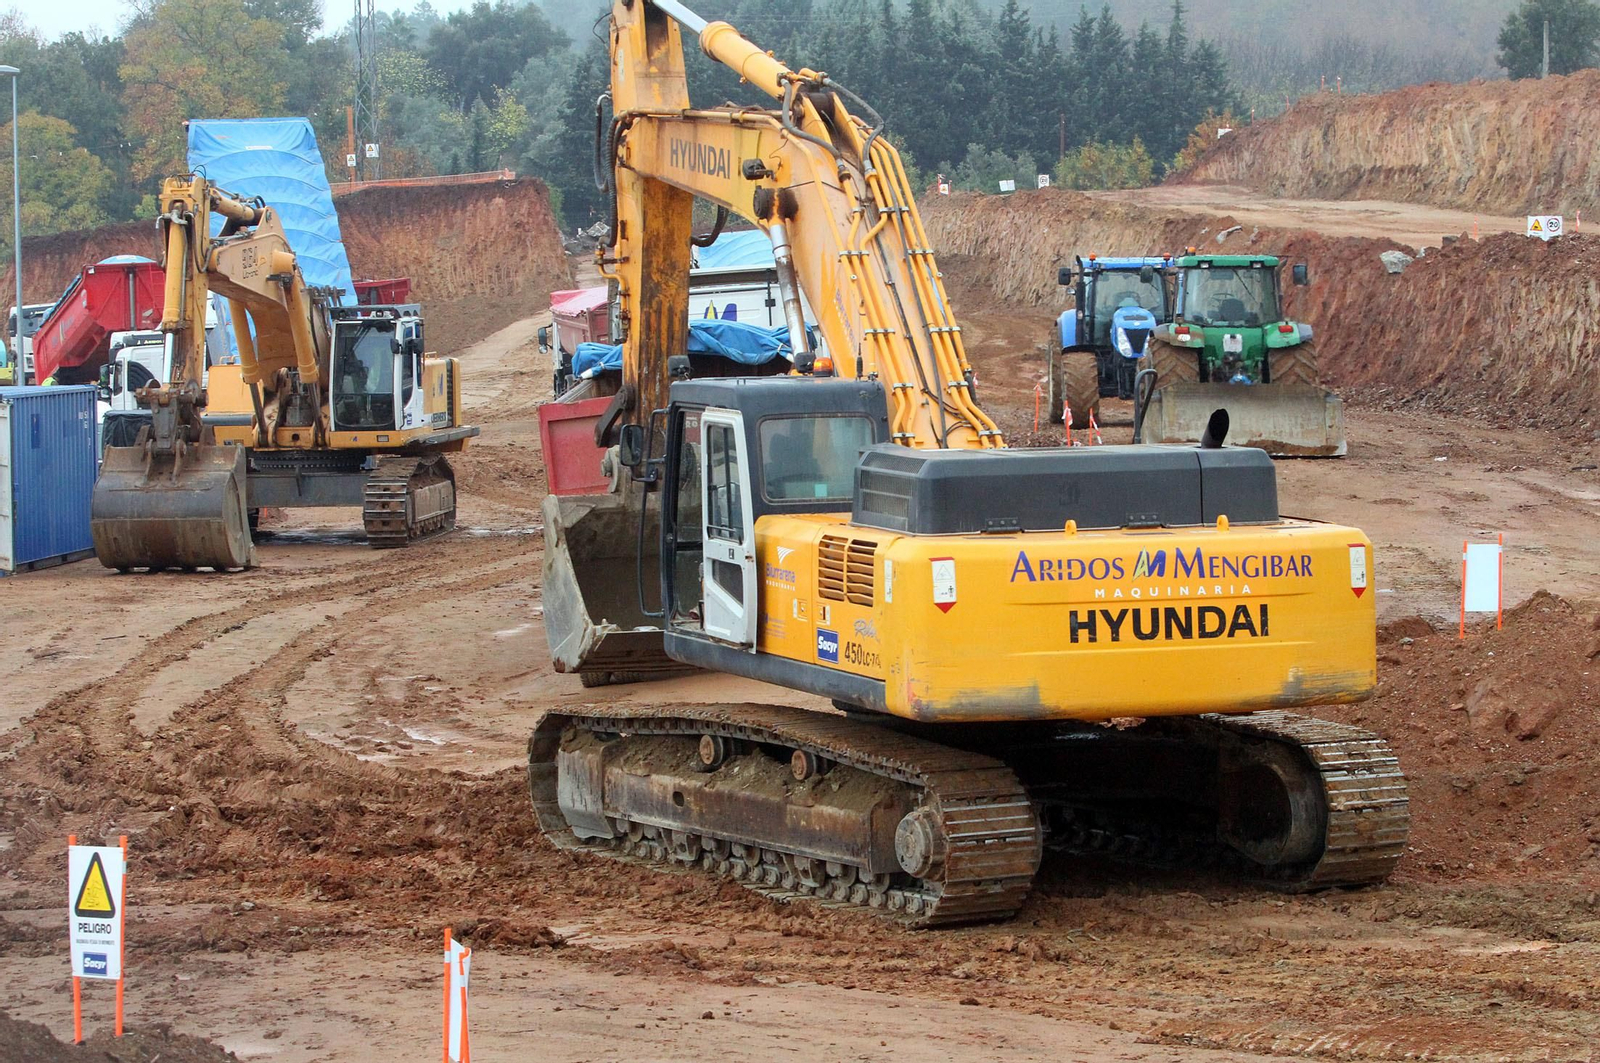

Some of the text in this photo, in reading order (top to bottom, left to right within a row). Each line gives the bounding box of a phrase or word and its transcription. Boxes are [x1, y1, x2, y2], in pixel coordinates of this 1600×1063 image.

[670, 138, 731, 180] HYUNDAI
[1010, 551, 1125, 582] ARIDOS
[1174, 547, 1313, 578] MENGIBAR
[1094, 584, 1251, 598] MAQUINARIA
[1069, 603, 1270, 643] HYUNDAI
[818, 636, 838, 653] Sacyr
[78, 923, 112, 934] PELIGRO
[84, 958, 106, 969] Sacyr
